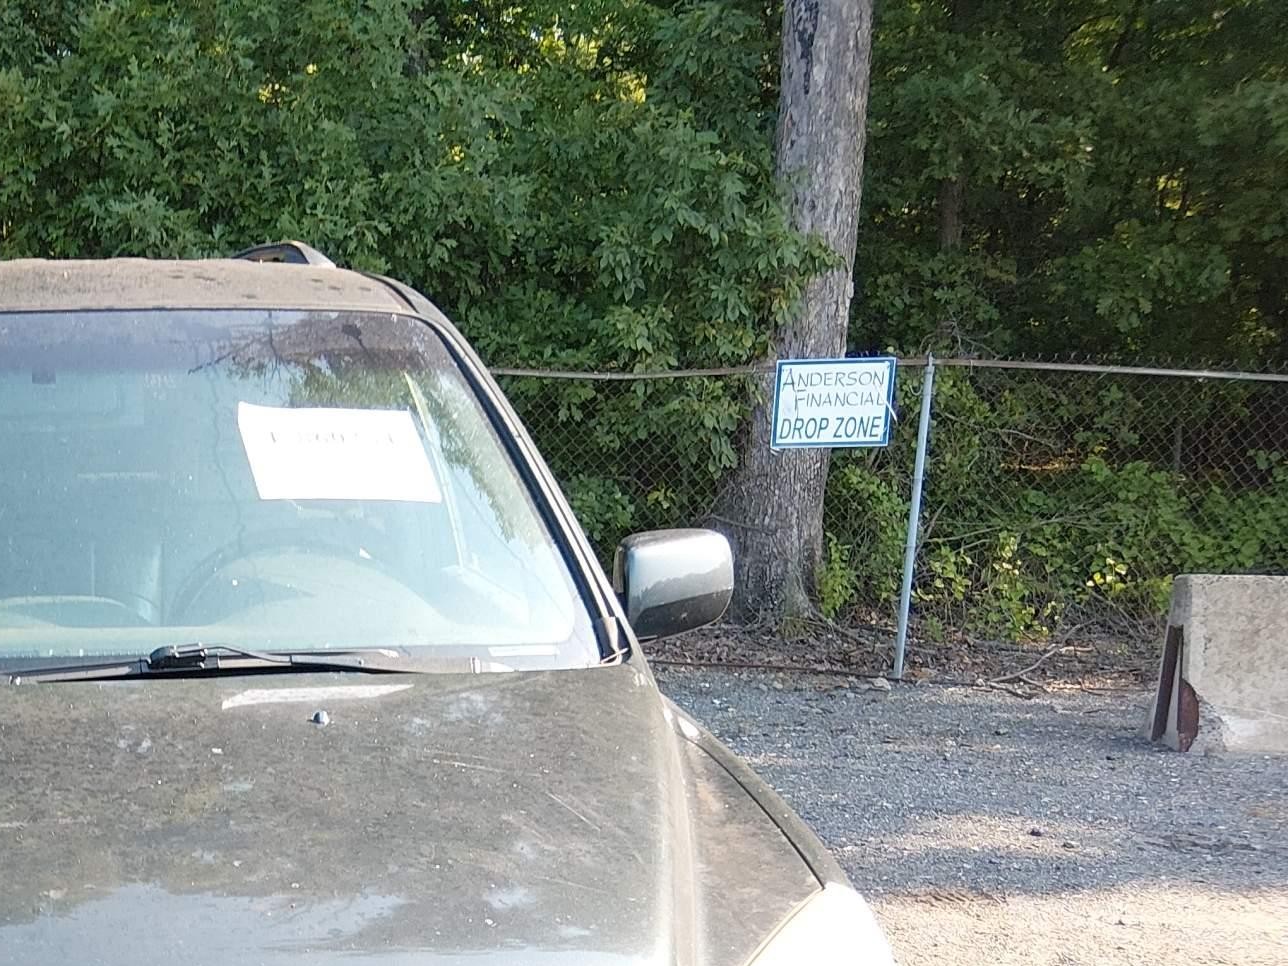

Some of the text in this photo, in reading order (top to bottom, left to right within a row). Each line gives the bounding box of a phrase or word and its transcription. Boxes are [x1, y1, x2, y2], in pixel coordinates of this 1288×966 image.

[782, 367, 885, 392] ANDERSON
[794, 388, 886, 411] FINANCIAL
[779, 415, 883, 440] DROP ZONE
